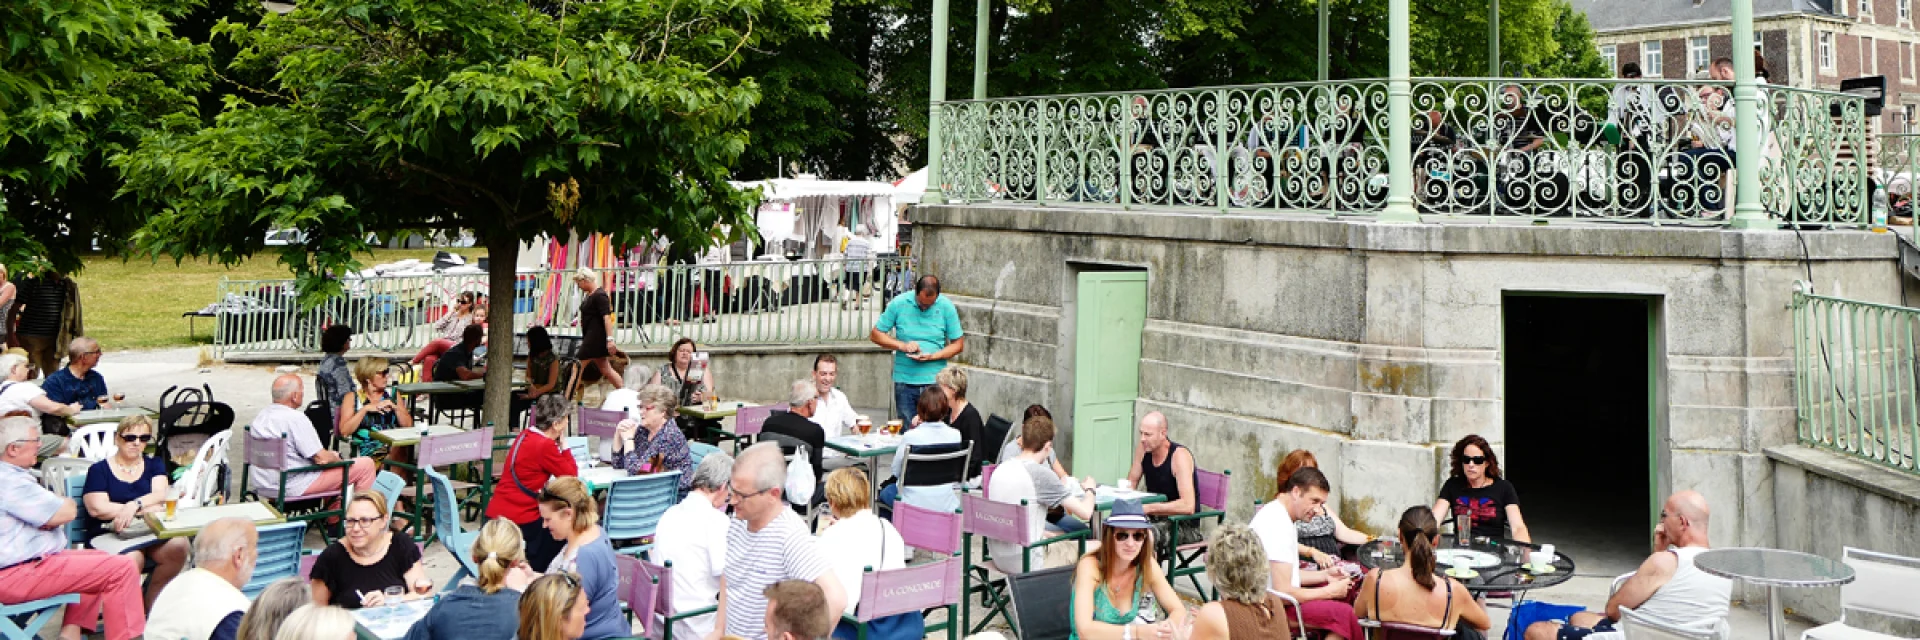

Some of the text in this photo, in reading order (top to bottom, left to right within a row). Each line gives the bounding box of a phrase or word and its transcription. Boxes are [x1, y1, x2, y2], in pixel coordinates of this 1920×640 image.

[983, 513, 1014, 527] CONCORDE
[883, 579, 942, 597] LA CONCORDE
